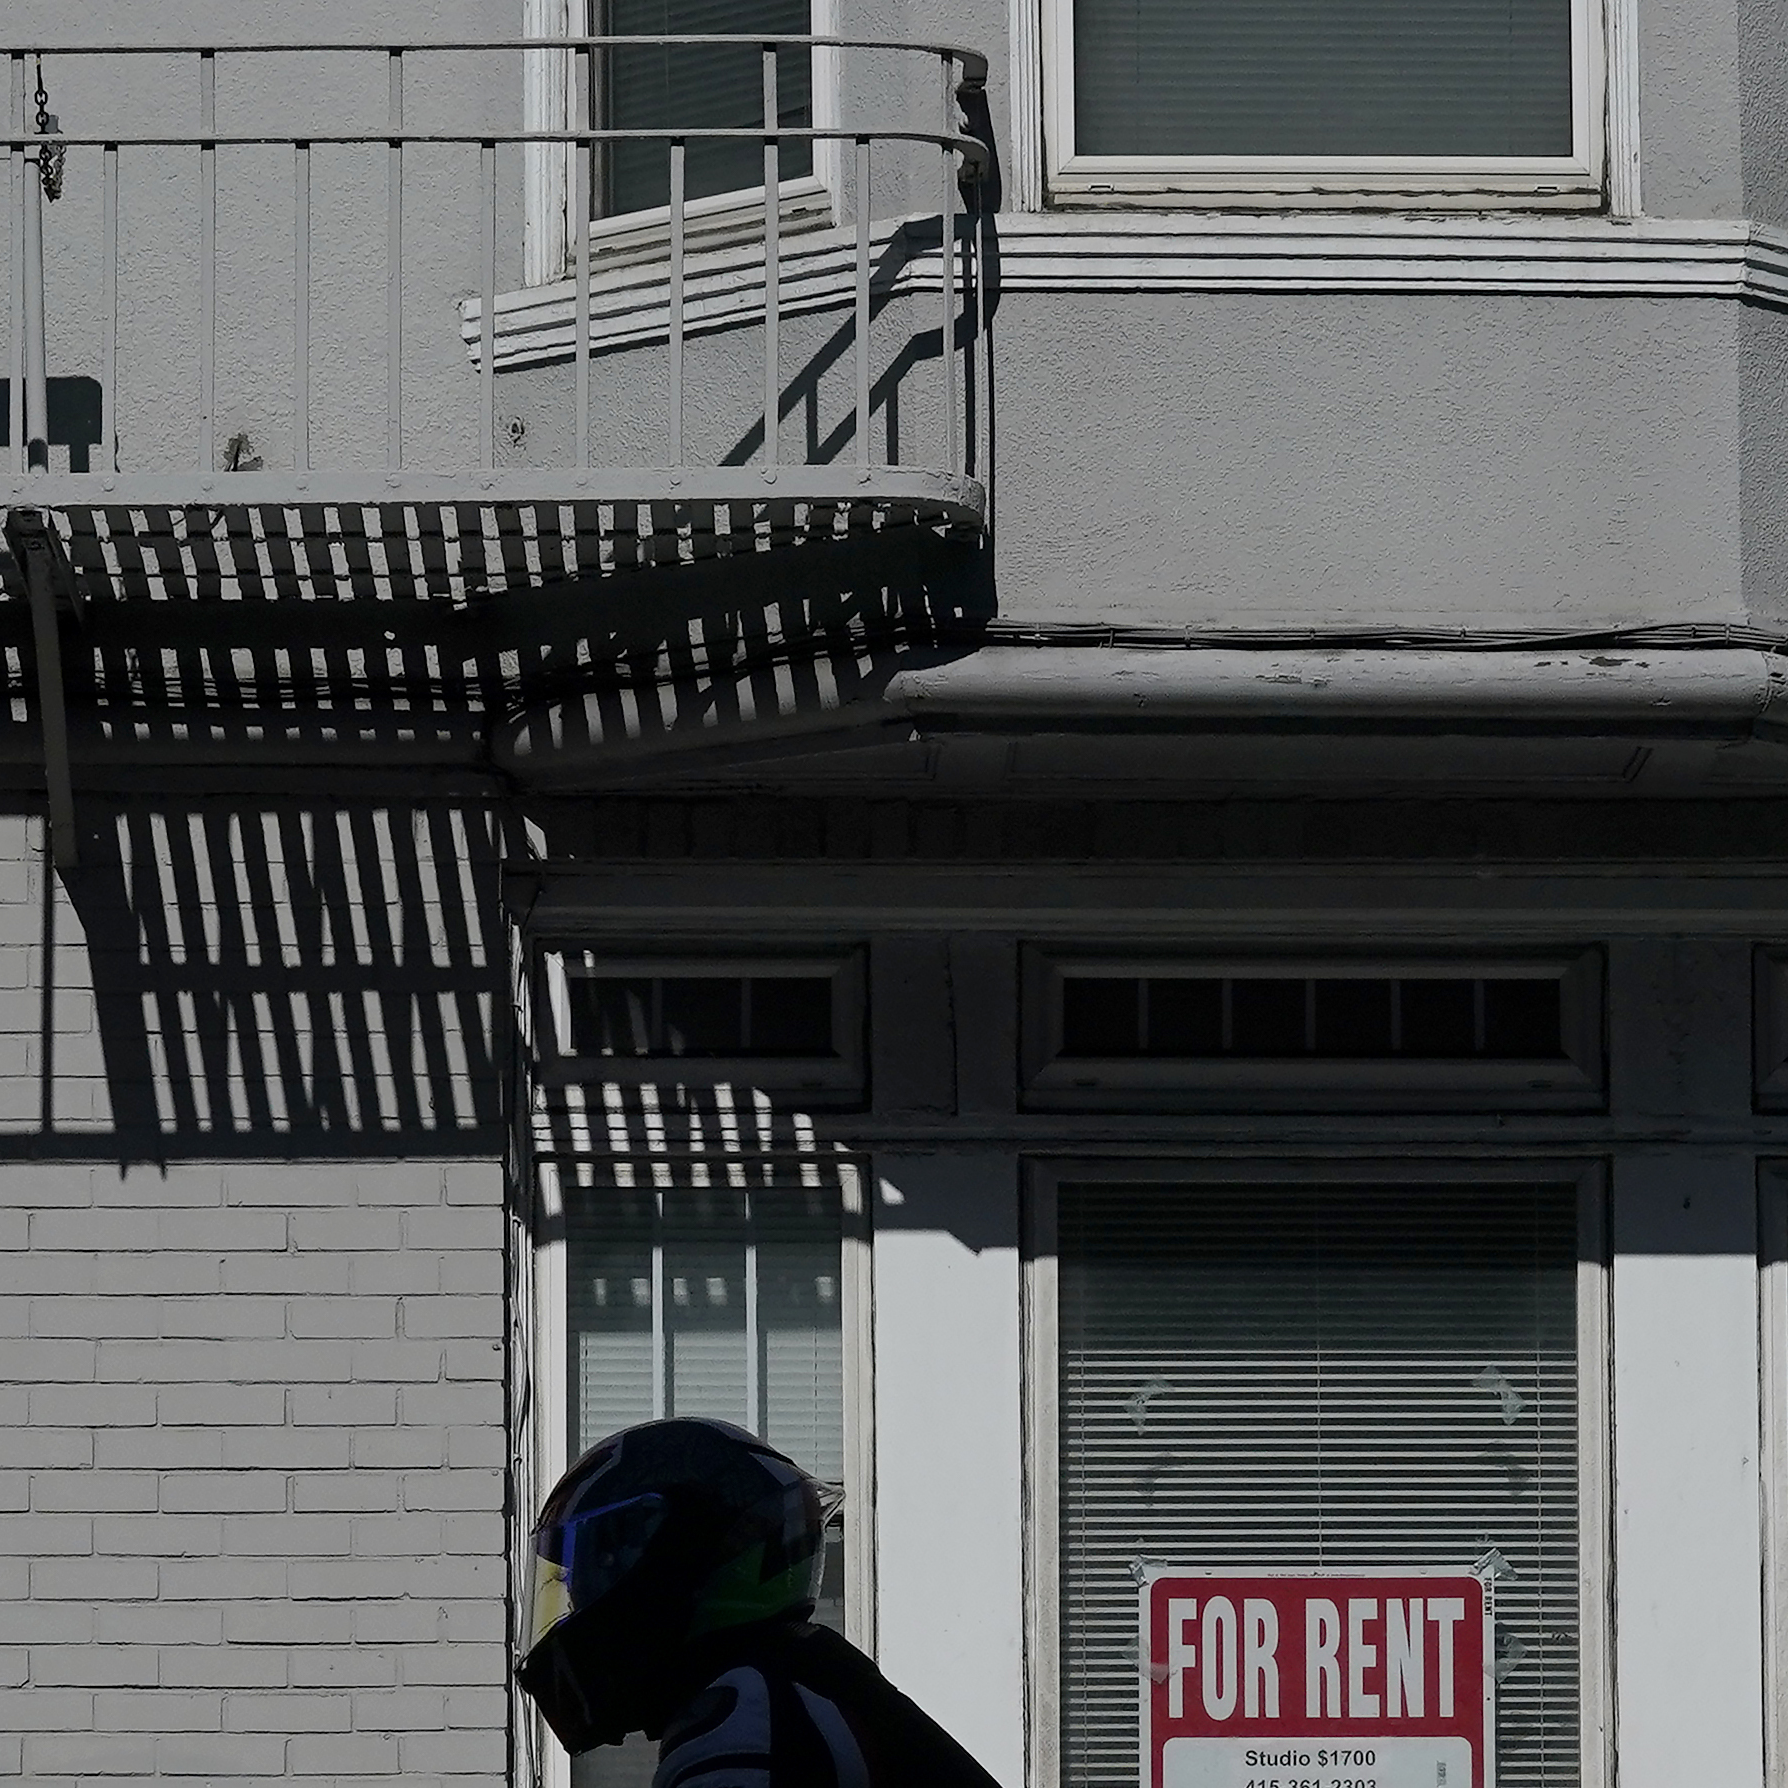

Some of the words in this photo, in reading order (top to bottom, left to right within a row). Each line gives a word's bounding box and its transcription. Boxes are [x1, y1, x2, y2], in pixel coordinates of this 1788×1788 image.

[1168, 1595, 1280, 1721] FOR
[1305, 1597, 1466, 1719] RENT
[1245, 1750, 1311, 1767] Studio
[1317, 1749, 1376, 1768] $1700
